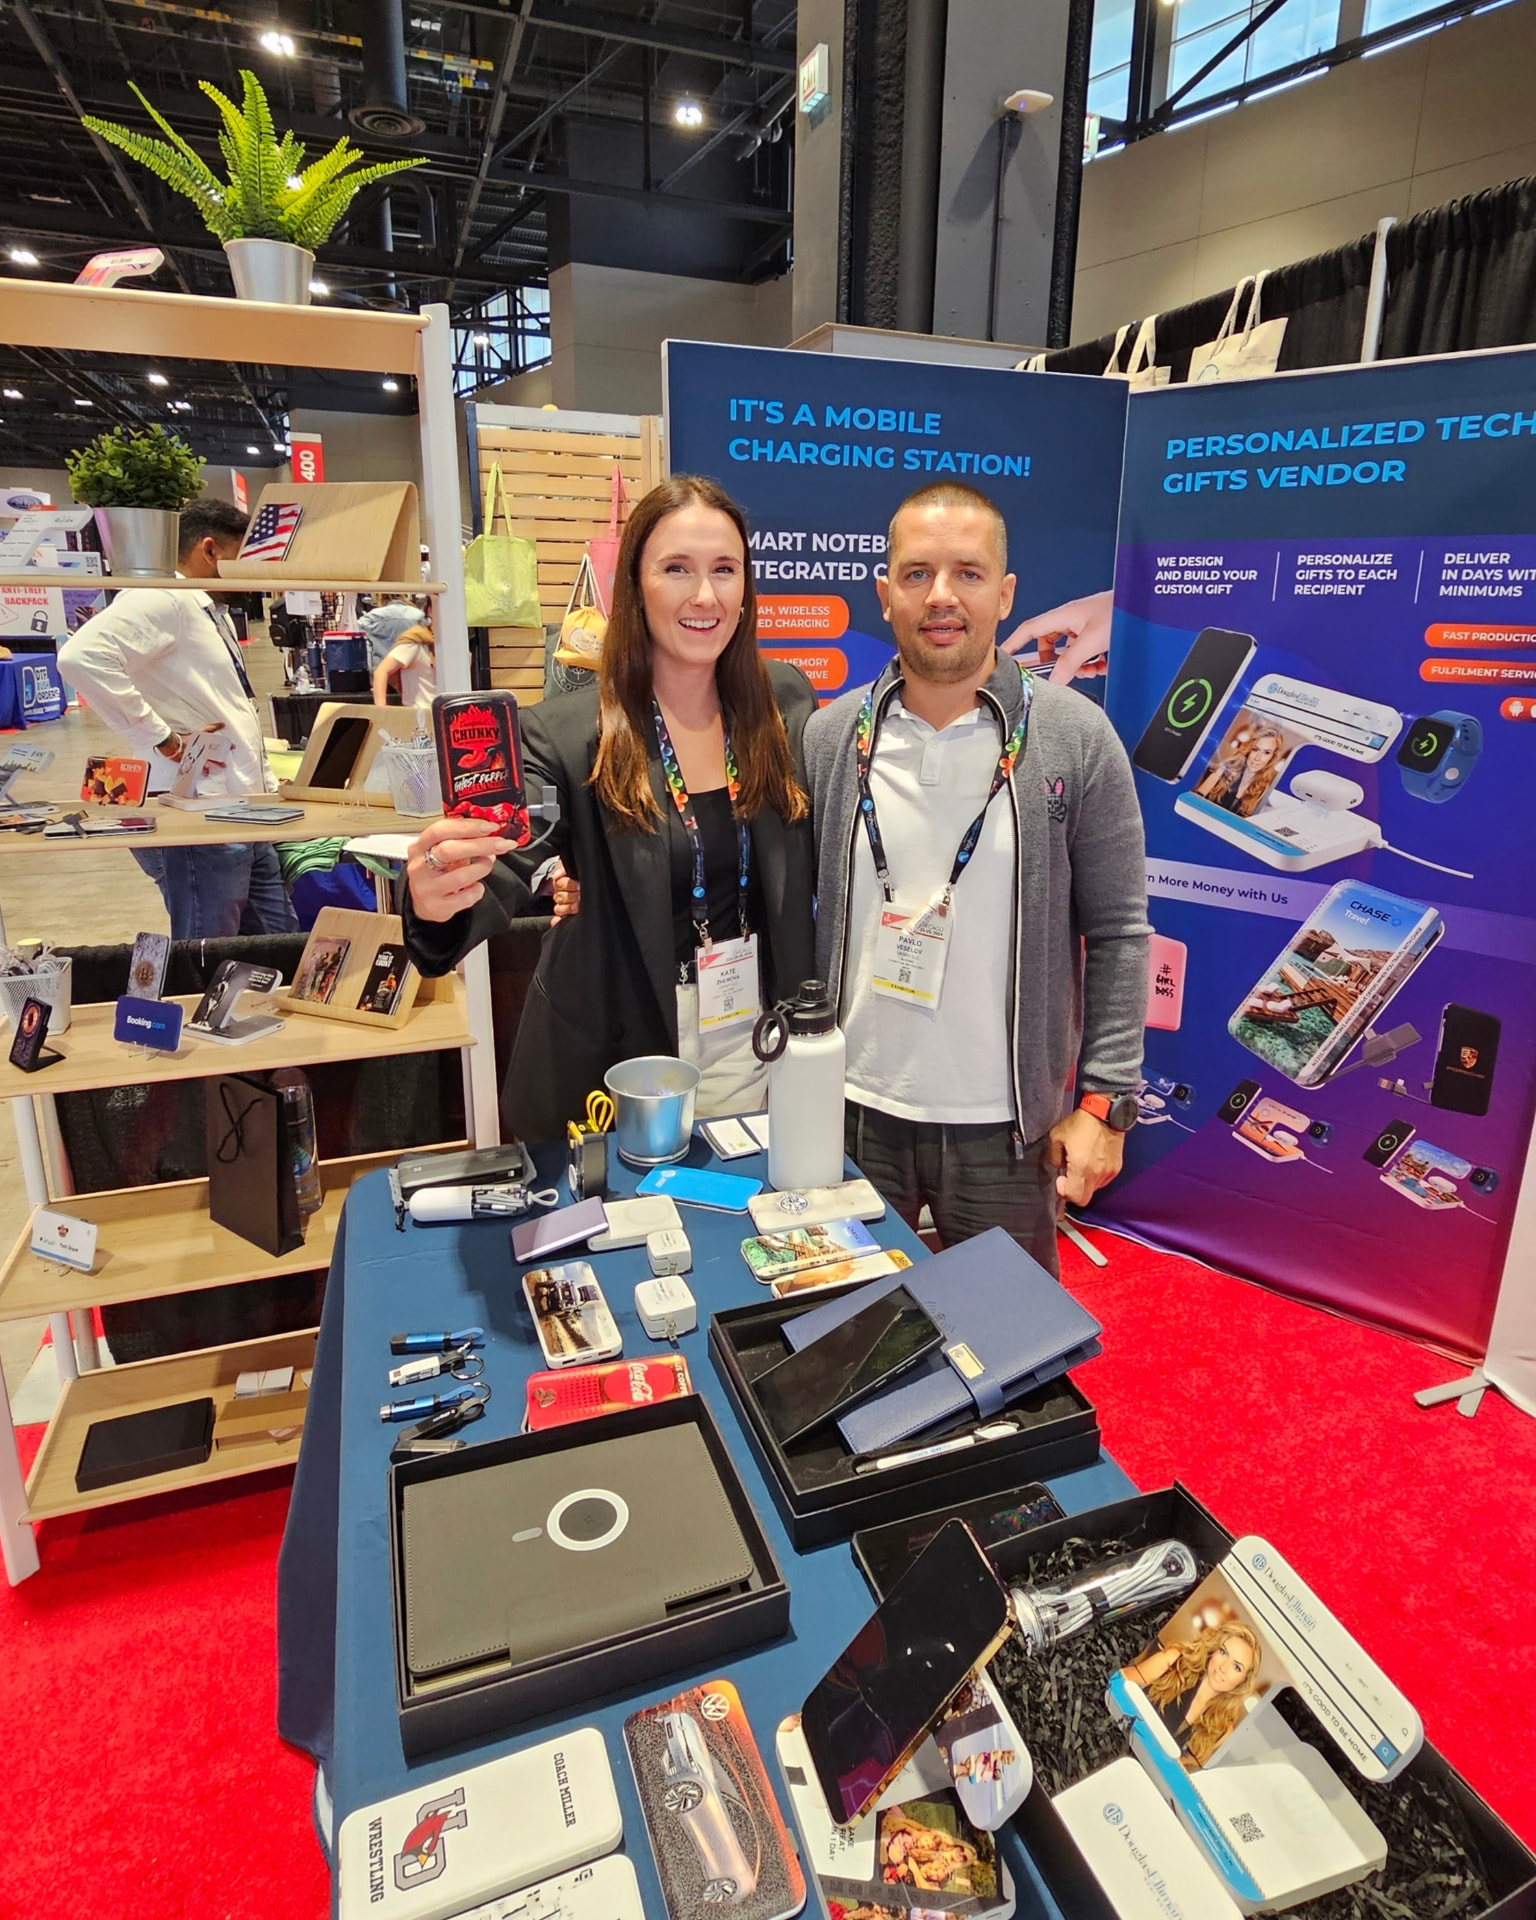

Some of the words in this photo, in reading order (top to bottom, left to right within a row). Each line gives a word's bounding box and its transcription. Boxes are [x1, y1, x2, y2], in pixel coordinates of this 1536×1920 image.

[729, 398, 784, 425] IT'S
[792, 403, 816, 426] A
[826, 406, 941, 435] MOBILE
[1166, 420, 1425, 460] PERSONALIZED
[1436, 411, 1536, 441] TECH
[728, 438, 895, 469] CHARGING
[903, 448, 1031, 477] STATION!
[300, 450, 316, 481] 400
[1162, 468, 1248, 494] GIFTS
[1256, 460, 1406, 489] VENDOR
[748, 531, 806, 551] MART
[812, 533, 888, 553] NOTEB
[1157, 557, 1177, 567] WE
[1179, 556, 1223, 567] DESIGN
[1297, 554, 1393, 565] PERSONALIZE
[1444, 553, 1510, 564] DELIVER
[751, 560, 868, 580] TEGRATED
[1155, 571, 1181, 580] AND
[1184, 570, 1220, 580] BUILD
[1223, 570, 1258, 580] YOUR
[1295, 569, 1333, 580] GIFTS
[1336, 569, 1355, 580] TO
[1358, 569, 1398, 580] EACH
[1441, 569, 1458, 580] IN
[1462, 569, 1503, 581] DAYS
[1154, 584, 1202, 594] CUSTOM
[1205, 584, 1233, 594] GIFT
[1294, 584, 1365, 595] RECIPIENT
[1439, 585, 1523, 597] MINIMUMS
[4, 597, 48, 605] BACKPACK
[757, 606, 776, 616] AH,
[779, 606, 830, 615] WIRELESS
[757, 619, 773, 628] ED
[775, 619, 830, 628] CHARGING
[1442, 631, 1470, 640] FAST
[784, 658, 829, 667] MEMORY
[807, 671, 829, 679] RIVE
[1431, 666, 1498, 677] FULFILMENT
[1500, 669, 1536, 679] SERVI
[452, 727, 500, 743] CHUNKY
[454, 773, 480, 793] GHOST
[1158, 874, 1189, 888] More
[1192, 880, 1234, 897] Money
[1237, 888, 1267, 901] with
[1271, 892, 1288, 904] Us
[1344, 909, 1370, 926] Travel
[1350, 900, 1391, 922] CHASE
[899, 936, 922, 947] PAVLO
[1156, 974, 1176, 987] GIRL
[1155, 985, 1174, 998] BOSS
[126, 1015, 166, 1030] Booking.com
[1313, 1694, 1331, 1716] GOOD
[1331, 1716, 1339, 1727] TO
[1339, 1727, 1348, 1738] BE
[1348, 1738, 1367, 1761] HOME
[553, 1752, 568, 1786] COACH
[559, 1786, 577, 1828] MILLER
[839, 1828, 847, 1852] REAT
[829, 1843, 837, 1861] DAY
[368, 1816, 384, 1904] WRESTLING
